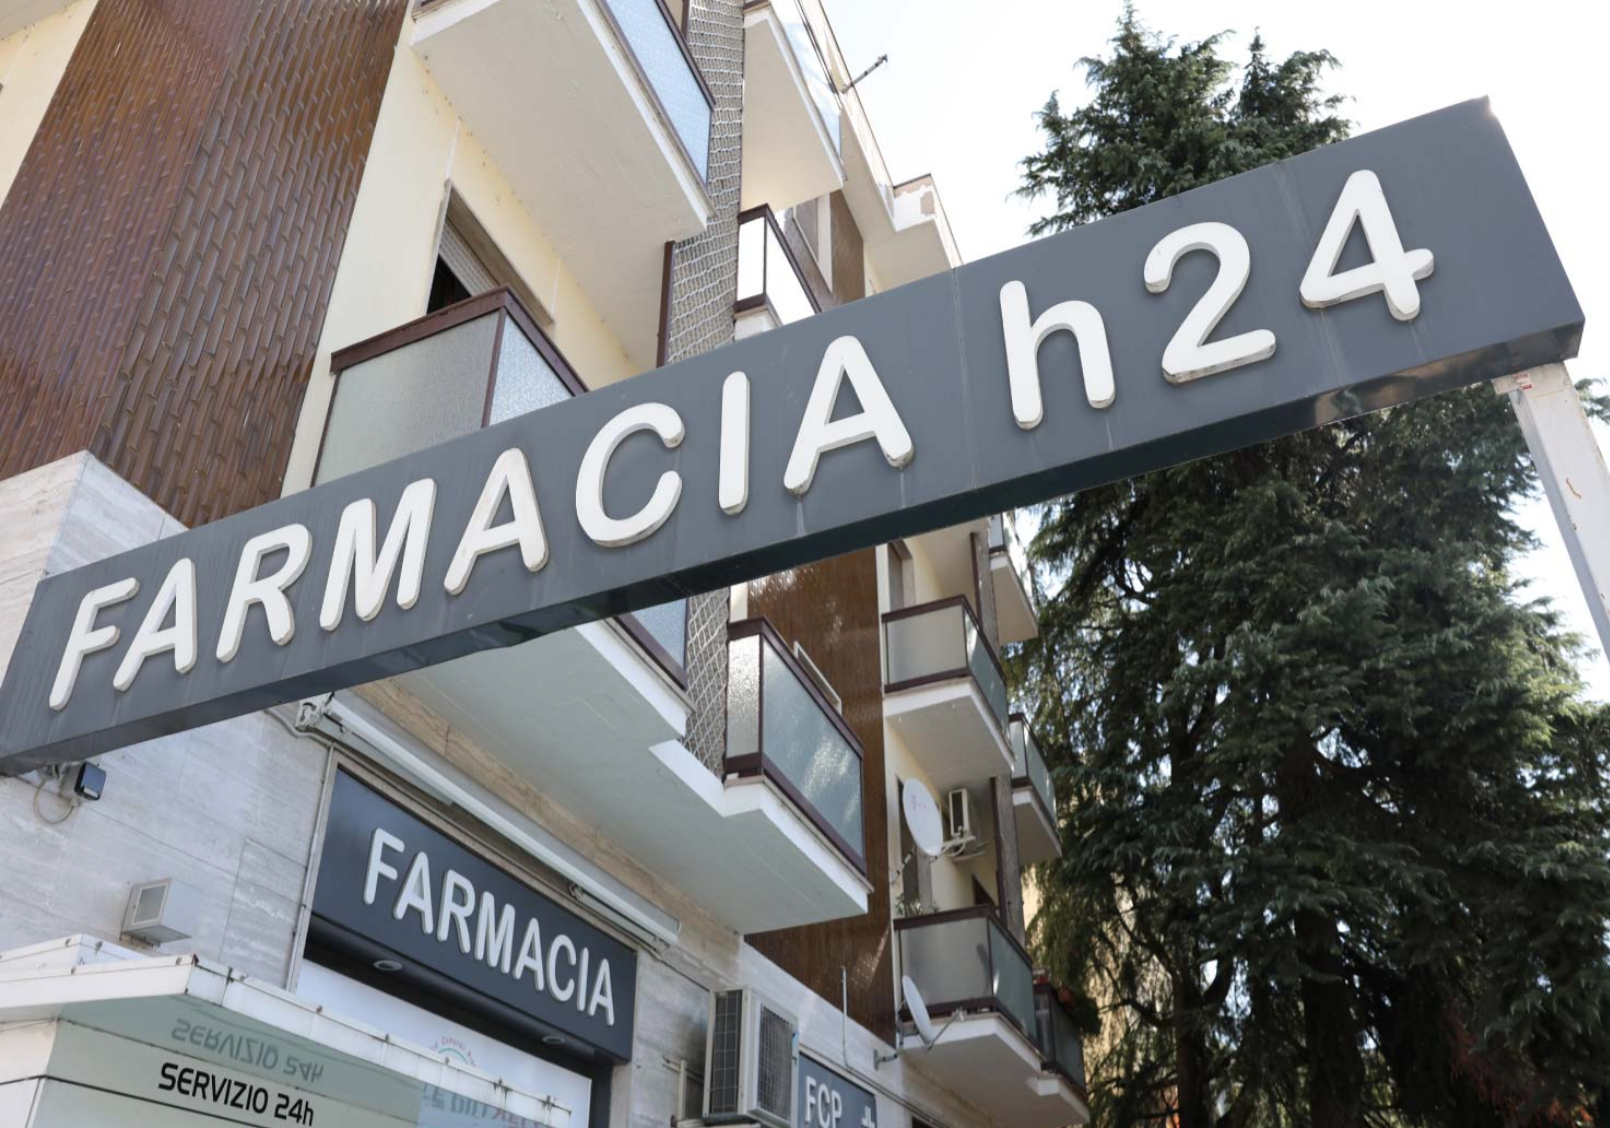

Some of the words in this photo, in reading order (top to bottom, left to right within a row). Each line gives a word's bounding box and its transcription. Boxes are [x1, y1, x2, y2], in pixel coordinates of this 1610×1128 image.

[49, 335, 914, 711] FARMACIA
[999, 169, 1434, 430] h24
[363, 827, 615, 1026] FARMACIA
[158, 1062, 269, 1115] SERVIZIO
[274, 1093, 315, 1127] 24h
[804, 1075, 843, 1128] FCP
